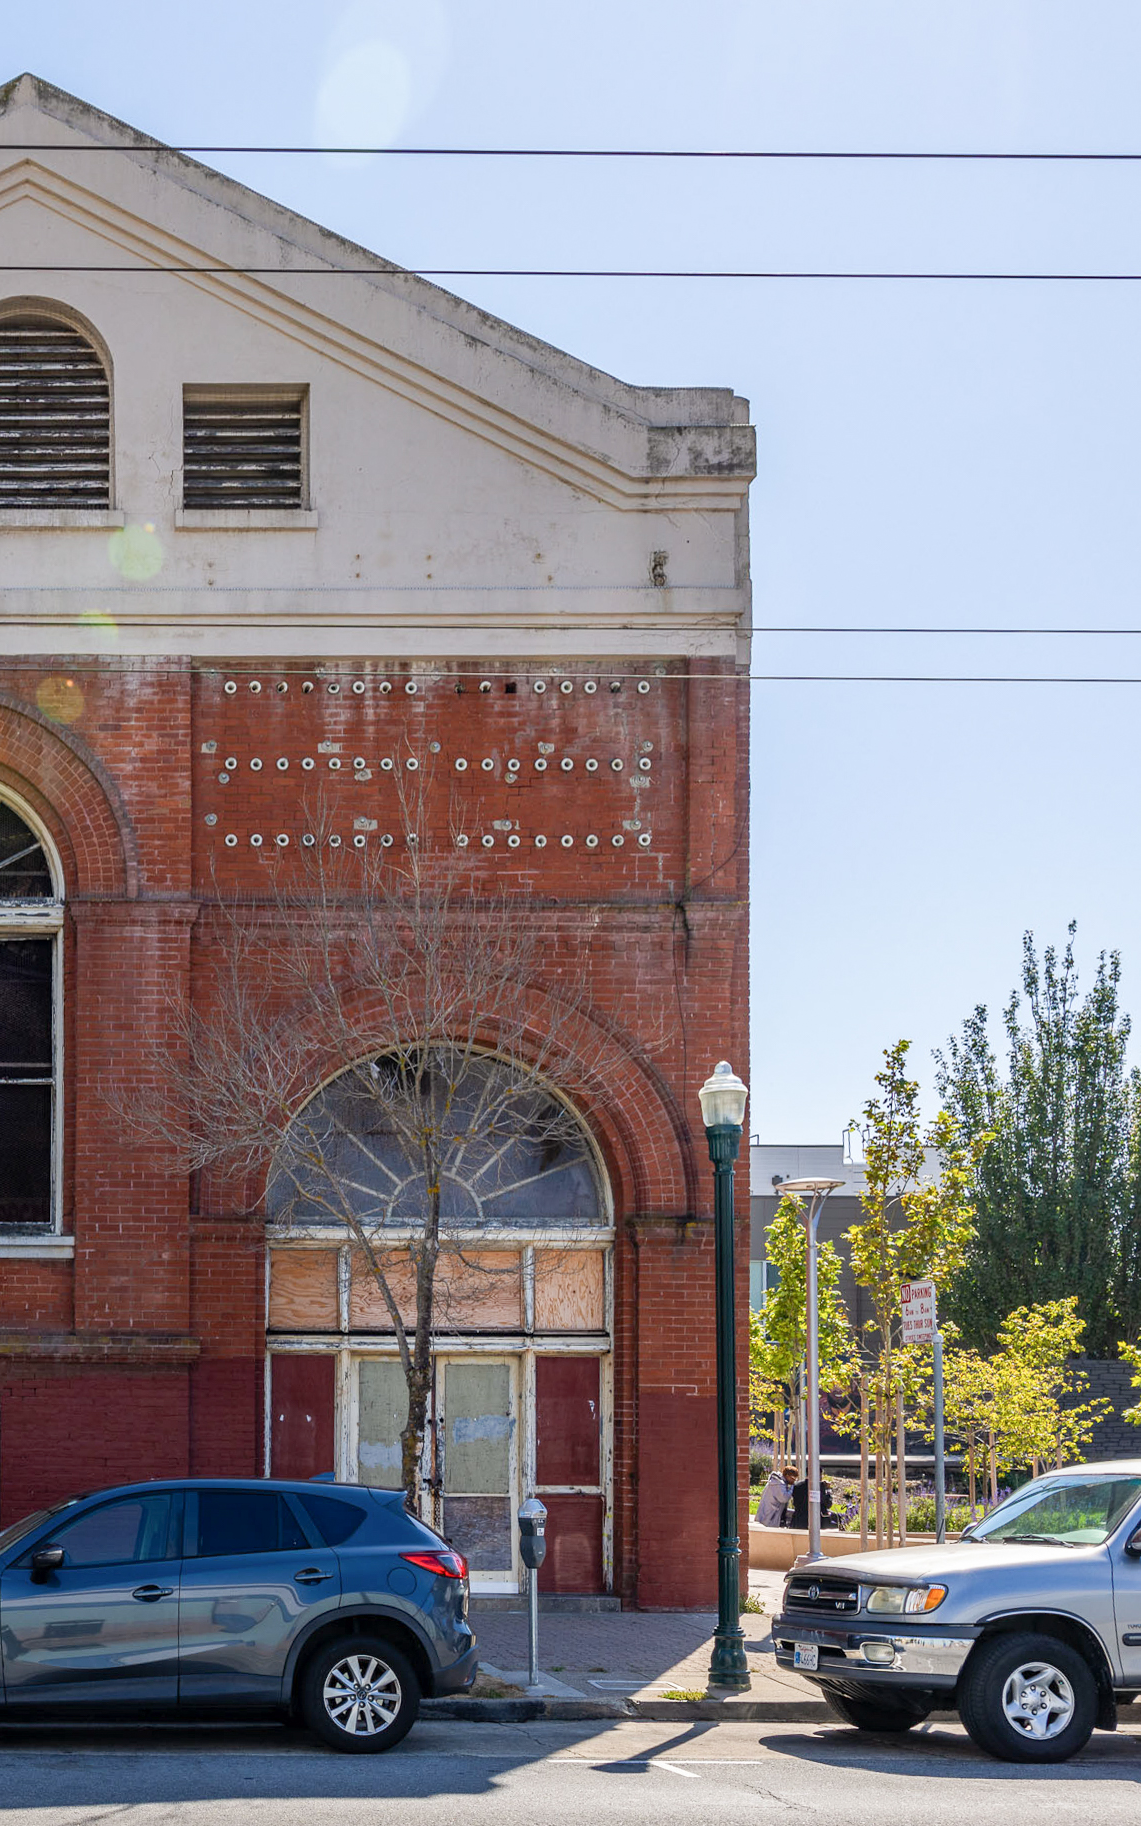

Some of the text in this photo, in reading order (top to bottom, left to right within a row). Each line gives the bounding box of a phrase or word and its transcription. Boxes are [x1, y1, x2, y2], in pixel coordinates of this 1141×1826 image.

[901, 1285, 932, 1303] NO PARKING
[903, 1321, 913, 1331] TUES
[924, 1318, 933, 1328] SUN
